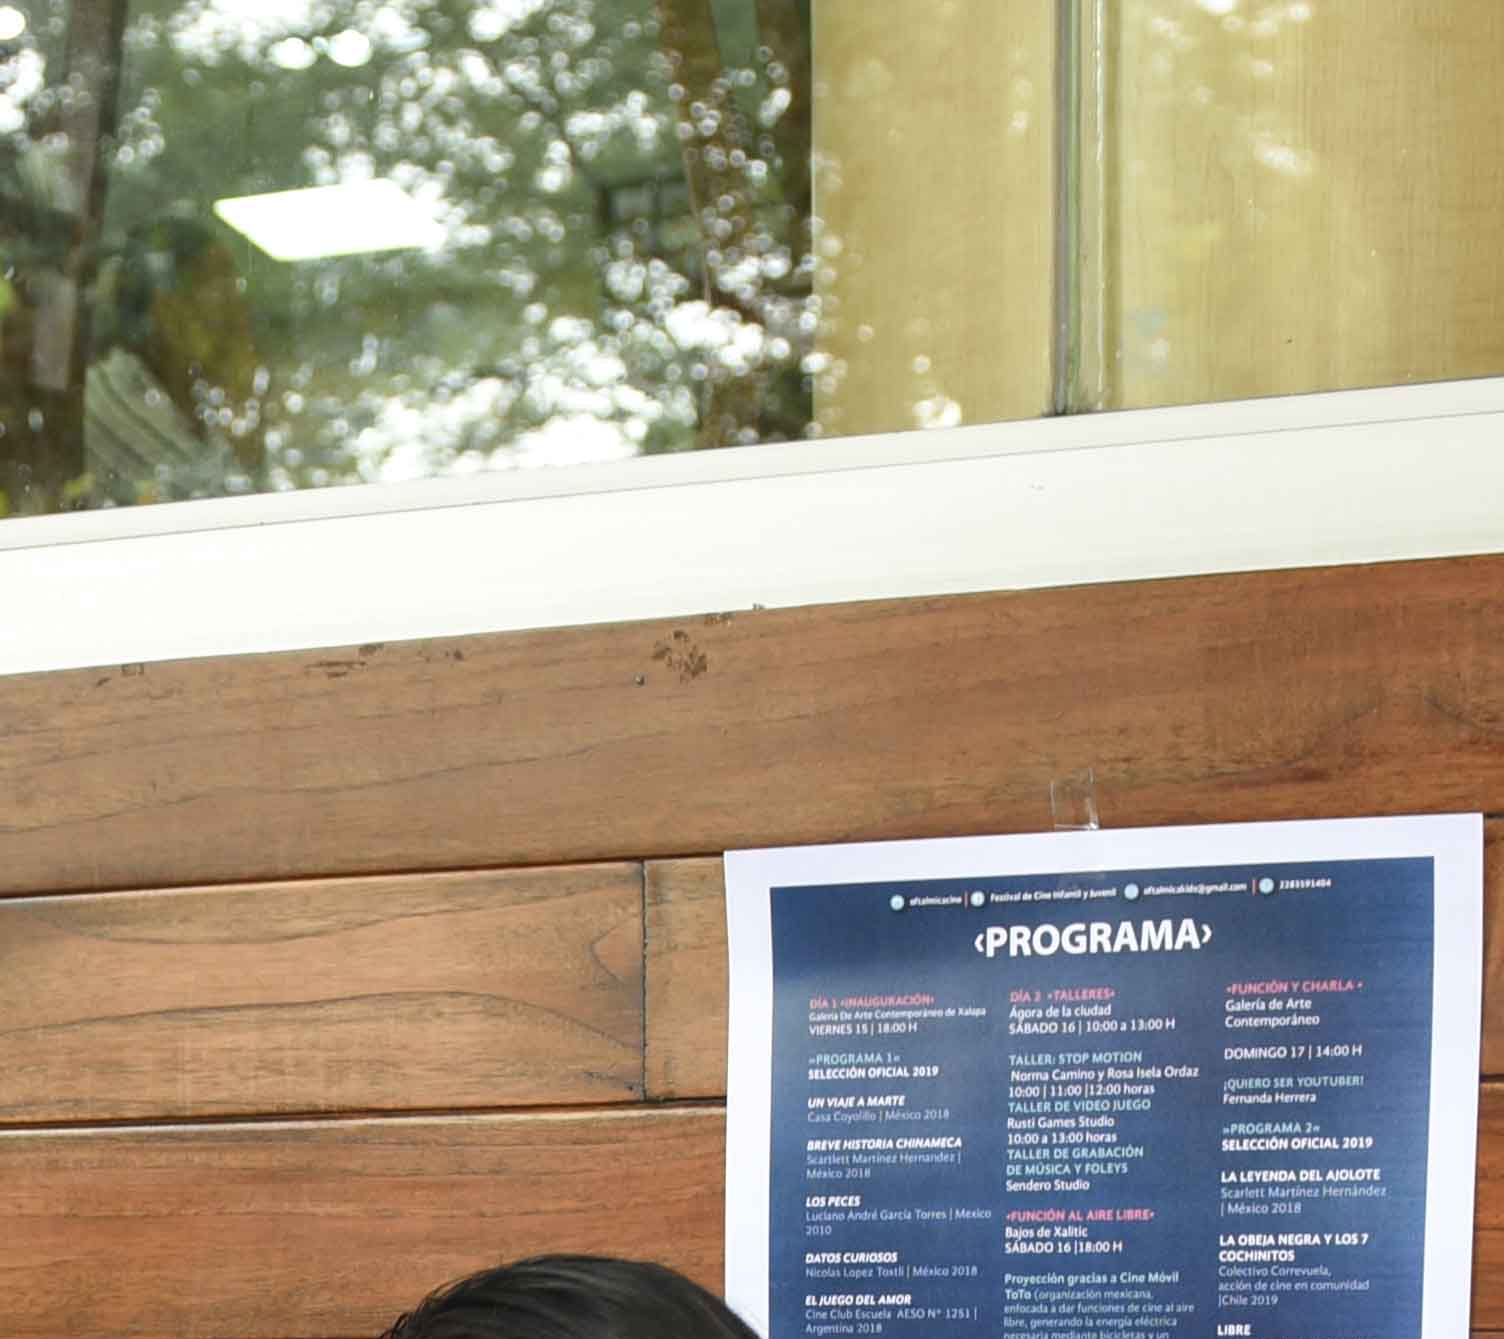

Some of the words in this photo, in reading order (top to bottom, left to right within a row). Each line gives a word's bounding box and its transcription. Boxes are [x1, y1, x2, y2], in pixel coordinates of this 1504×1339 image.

[1225, 999, 1266, 1012] Galería
[1268, 998, 1283, 1011] de
[1285, 998, 1312, 1010] Arte
[1009, 1004, 1043, 1021] Ágora
[1045, 1006, 1060, 1018] de
[1061, 1006, 1072, 1017] la
[1074, 1005, 1112, 1017] ciudad
[1224, 1014, 1321, 1030] Contemporáneo
[1008, 1054, 1057, 1066] TALLER:
[1058, 1053, 1090, 1065] STOP
[1092, 1052, 1143, 1064] MOTION
[808, 1065, 866, 1080] SELECCIÓN
[867, 1066, 910, 1079] OFICIAL
[912, 1065, 939, 1078] 2019
[1010, 1070, 1050, 1081] Norma
[1051, 1068, 1096, 1081] Camino
[1096, 1070, 1105, 1082] y
[1107, 1068, 1135, 1079] Rosa
[1137, 1067, 1162, 1079] Isela
[1163, 1066, 1200, 1078] Ordaz
[807, 1097, 825, 1109] UN
[827, 1097, 855, 1109] VIAJE
[856, 1096, 866, 1108] A
[867, 1095, 906, 1107] MARTE
[1222, 1093, 1273, 1105] Fernanda
[1274, 1092, 1317, 1104] Herrera
[1007, 1101, 1052, 1114] TALLER
[1054, 1100, 1071, 1113] DE
[1073, 1100, 1111, 1112] VIDEO
[1111, 1099, 1151, 1112] JUEGO
[1007, 1117, 1035, 1129] Rusti
[1037, 1116, 1077, 1129] Games
[1078, 1116, 1115, 1128] Studio
[806, 1139, 841, 1152] BREVE
[843, 1138, 894, 1151] HISTORIA
[896, 1137, 963, 1150] CHINAMECA
[1221, 1136, 1289, 1151] SELECCIÓN
[1291, 1137, 1340, 1150] OFICIAL
[1342, 1137, 1374, 1149] 2019
[1007, 1148, 1050, 1161] TALLER
[1053, 1148, 1069, 1160] DE
[1071, 1144, 1144, 1159] GRABACIÓN
[1221, 1171, 1238, 1183] LA
[1240, 1170, 1297, 1183] LEYENDA
[1299, 1169, 1323, 1182] DEL
[1326, 1168, 1381, 1182] AJOLOTE
[1005, 1180, 1052, 1192] Sendero
[1053, 1179, 1090, 1191] Studio
[805, 1196, 826, 1207] LOS
[827, 1195, 861, 1207] PECES
[1004, 1226, 1035, 1241] Bajos
[1036, 1226, 1051, 1238] de
[1219, 1234, 1235, 1246] LA
[1237, 1233, 1276, 1247] OBEJA
[1278, 1233, 1321, 1246] NEGRA
[1324, 1233, 1333, 1245] Y
[1335, 1232, 1359, 1245] LOS
[1360, 1232, 1369, 1245] 7
[805, 1252, 842, 1264] DATOS
[843, 1252, 898, 1264] CURIOSOS
[1218, 1250, 1296, 1262] COCHINITOS
[805, 1295, 818, 1306] EL
[819, 1295, 853, 1307] JUEGO
[855, 1294, 876, 1306] DEL
[877, 1294, 912, 1305] AMOR
[1216, 1324, 1252, 1336] LIBRE
